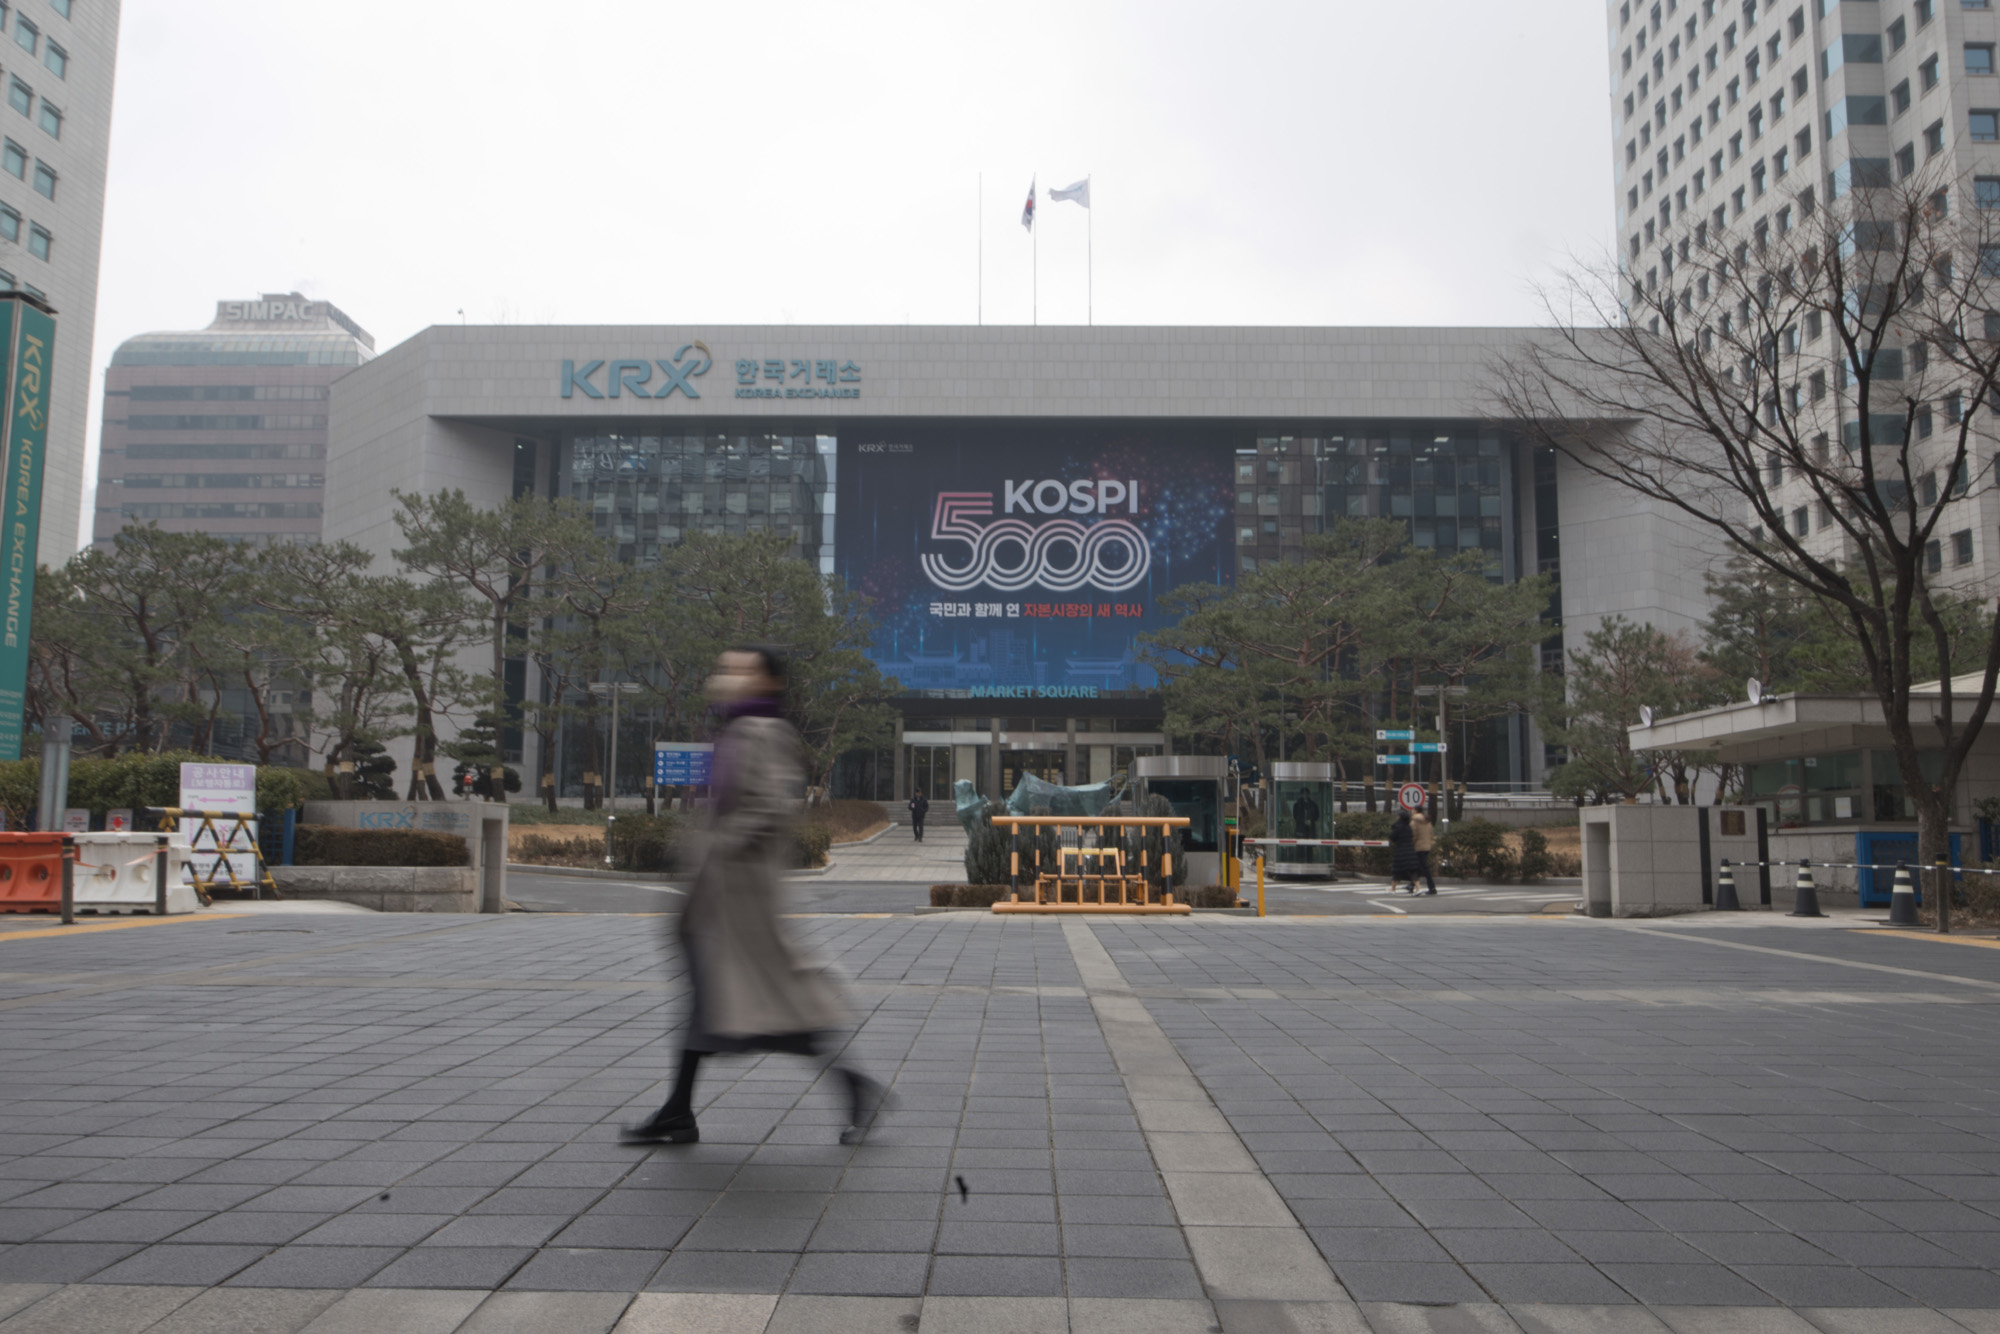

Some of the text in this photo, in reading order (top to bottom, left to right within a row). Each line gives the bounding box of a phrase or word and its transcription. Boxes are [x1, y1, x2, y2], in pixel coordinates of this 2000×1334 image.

[226, 301, 315, 322] SIMPAC
[18, 332, 45, 422] KRX
[561, 358, 704, 399] KRX
[734, 359, 862, 385] 한국거래소
[734, 388, 861, 399] KOREA EXCHANGE
[858, 443, 885, 453] KRX
[1003, 479, 1138, 514] KOSPI
[5, 436, 33, 649] KOREA EXCHANGE
[920, 491, 1151, 592] 5000
[929, 602, 1143, 618] 국민과 함께 연 자본시장의 새 역사
[970, 685, 1099, 699] MARKET SQUARE
[191, 766, 245, 779] 공사안내
[1404, 790, 1421, 804] 10
[359, 811, 413, 829] KRX
